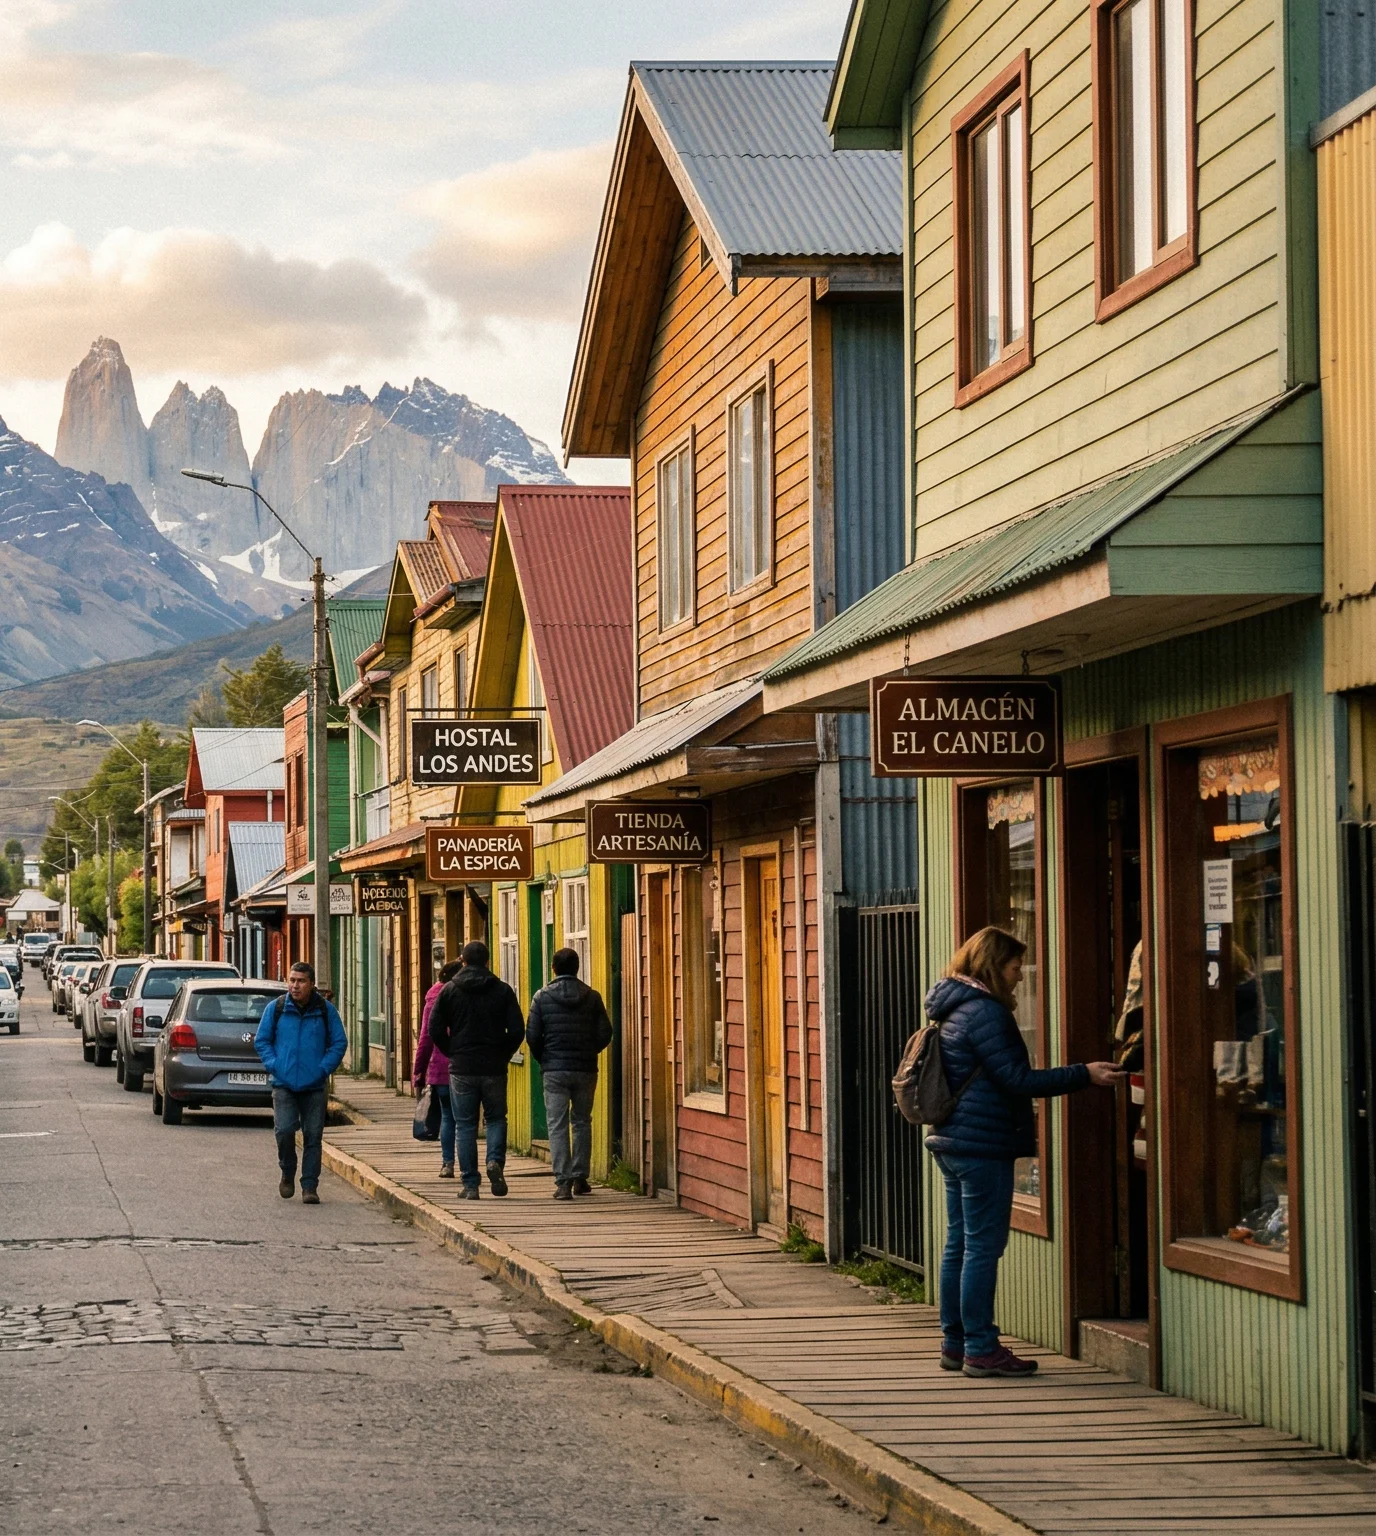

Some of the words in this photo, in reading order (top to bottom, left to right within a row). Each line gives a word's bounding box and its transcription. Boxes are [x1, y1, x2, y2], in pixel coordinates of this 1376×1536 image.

[898, 692, 1035, 722] ALMACÉN
[435, 727, 518, 747] HOSTAL
[892, 731, 926, 754] EL
[933, 731, 1045, 755] CANELO
[419, 754, 459, 774] LOS
[463, 754, 534, 773] ANDES
[615, 813, 685, 829] TIENDA
[437, 833, 523, 852] PANADERÍA
[596, 831, 702, 851] ARTESANÍA
[440, 856, 461, 871] LA
[464, 855, 521, 871] ESPIGA
